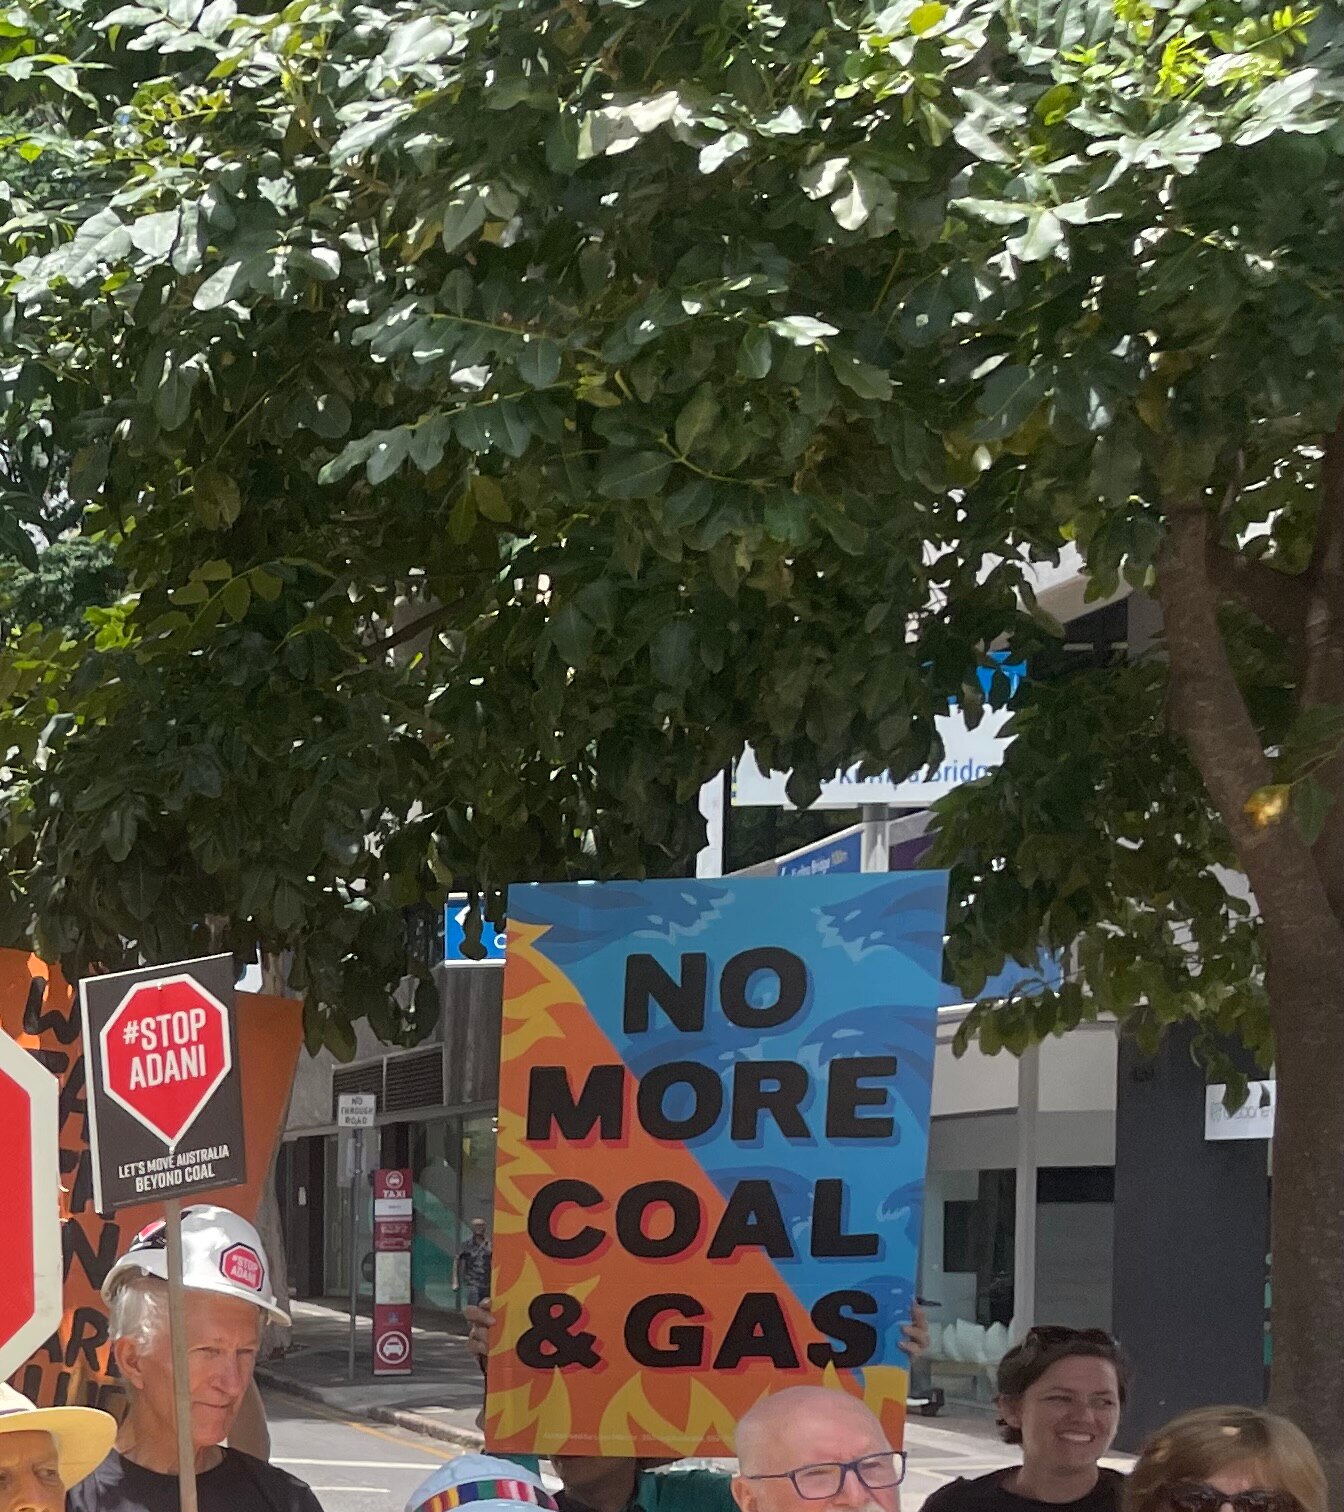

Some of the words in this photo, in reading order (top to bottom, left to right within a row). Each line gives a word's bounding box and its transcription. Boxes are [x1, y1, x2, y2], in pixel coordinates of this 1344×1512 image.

[623, 947, 807, 1034] NO
[123, 1008, 207, 1051] #STOP
[129, 1044, 207, 1091] ADANI
[527, 1056, 897, 1142] MORE
[118, 1162, 145, 1179] LET'S
[146, 1155, 174, 1174] MOVE
[176, 1145, 230, 1167] AUSTRALIA
[135, 1170, 183, 1193] BEYOND
[184, 1163, 216, 1183] COAL
[382, 1189, 407, 1198] TAXI
[527, 1179, 879, 1260] COAL
[516, 1293, 600, 1369] &
[623, 1289, 877, 1369] GAS
